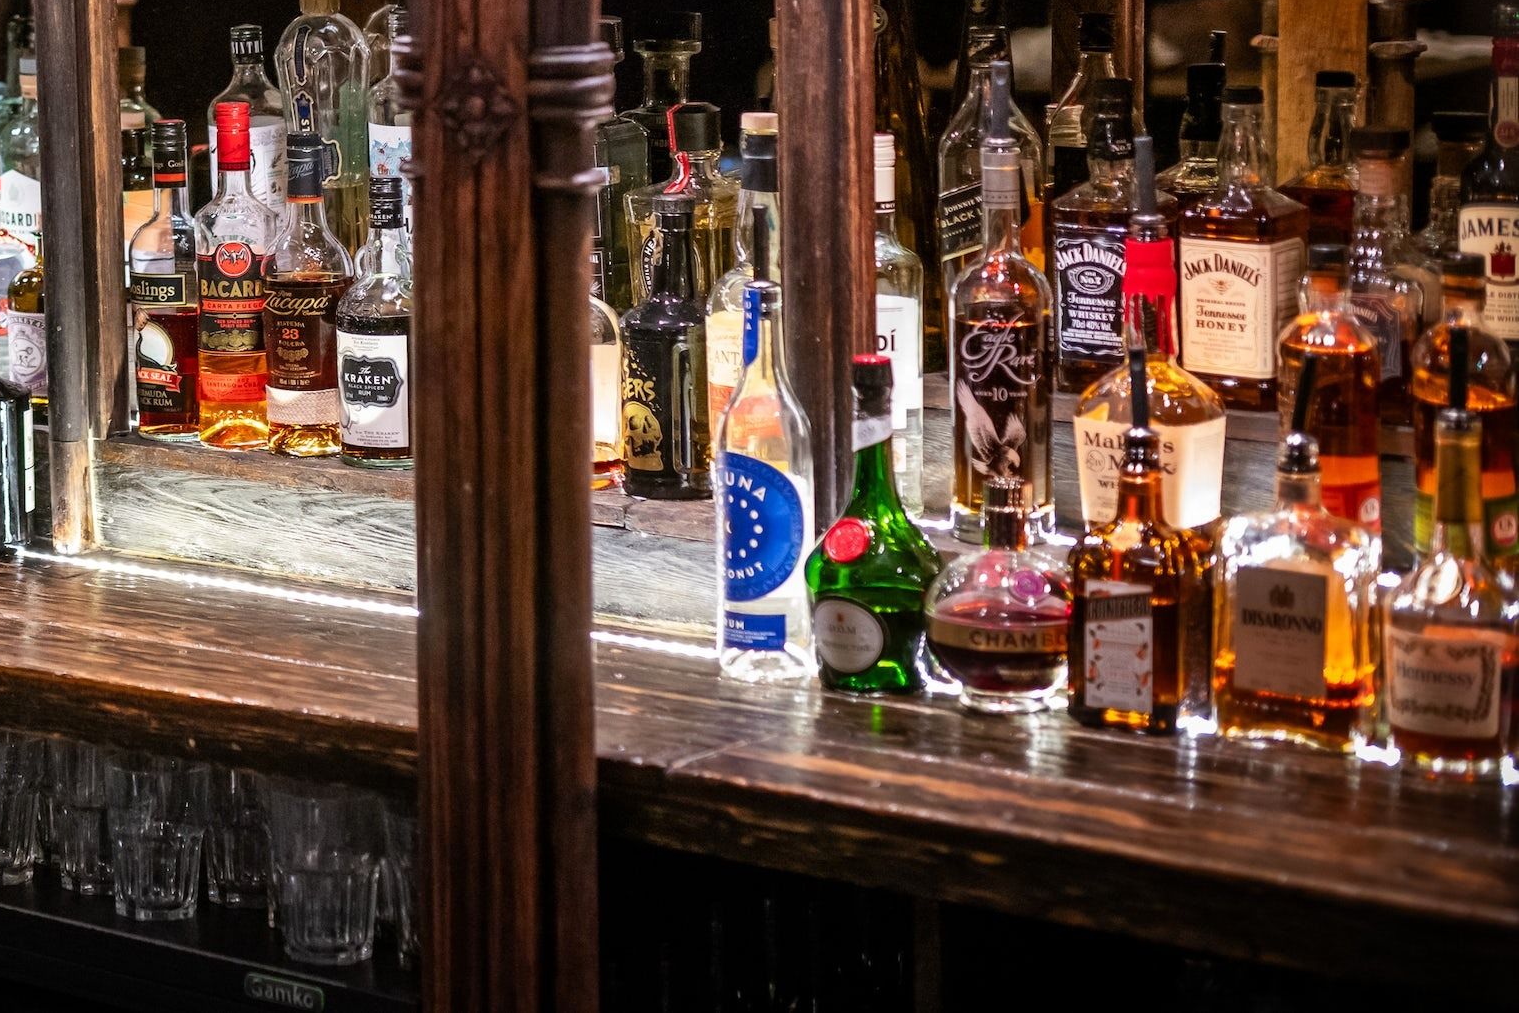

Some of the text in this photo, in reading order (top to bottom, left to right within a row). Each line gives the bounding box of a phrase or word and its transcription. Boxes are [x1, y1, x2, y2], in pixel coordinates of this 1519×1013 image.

[944, 199, 976, 216] JOHNNIE
[941, 209, 976, 229] BLACK
[1056, 242, 1127, 276] JACK DANIELS
[1183, 253, 1263, 287] JACK DANIEL'S
[263, 287, 329, 316] Zacapa
[1067, 291, 1117, 307] Tennessee
[1067, 308, 1117, 322] WHISKEY
[1195, 304, 1247, 322] Tennessee
[282, 327, 300, 340] 23
[1195, 318, 1248, 333] HONEY
[960, 312, 1025, 368] Eagle
[968, 343, 1041, 385] Rare
[150, 372, 173, 383] SEAL
[344, 372, 392, 385] KRAKEN
[358, 389, 372, 397] RUM
[992, 387, 1008, 402] 10
[153, 398, 173, 407] RUM
[1083, 430, 1175, 454] Maks
[717, 471, 767, 503] LUNA
